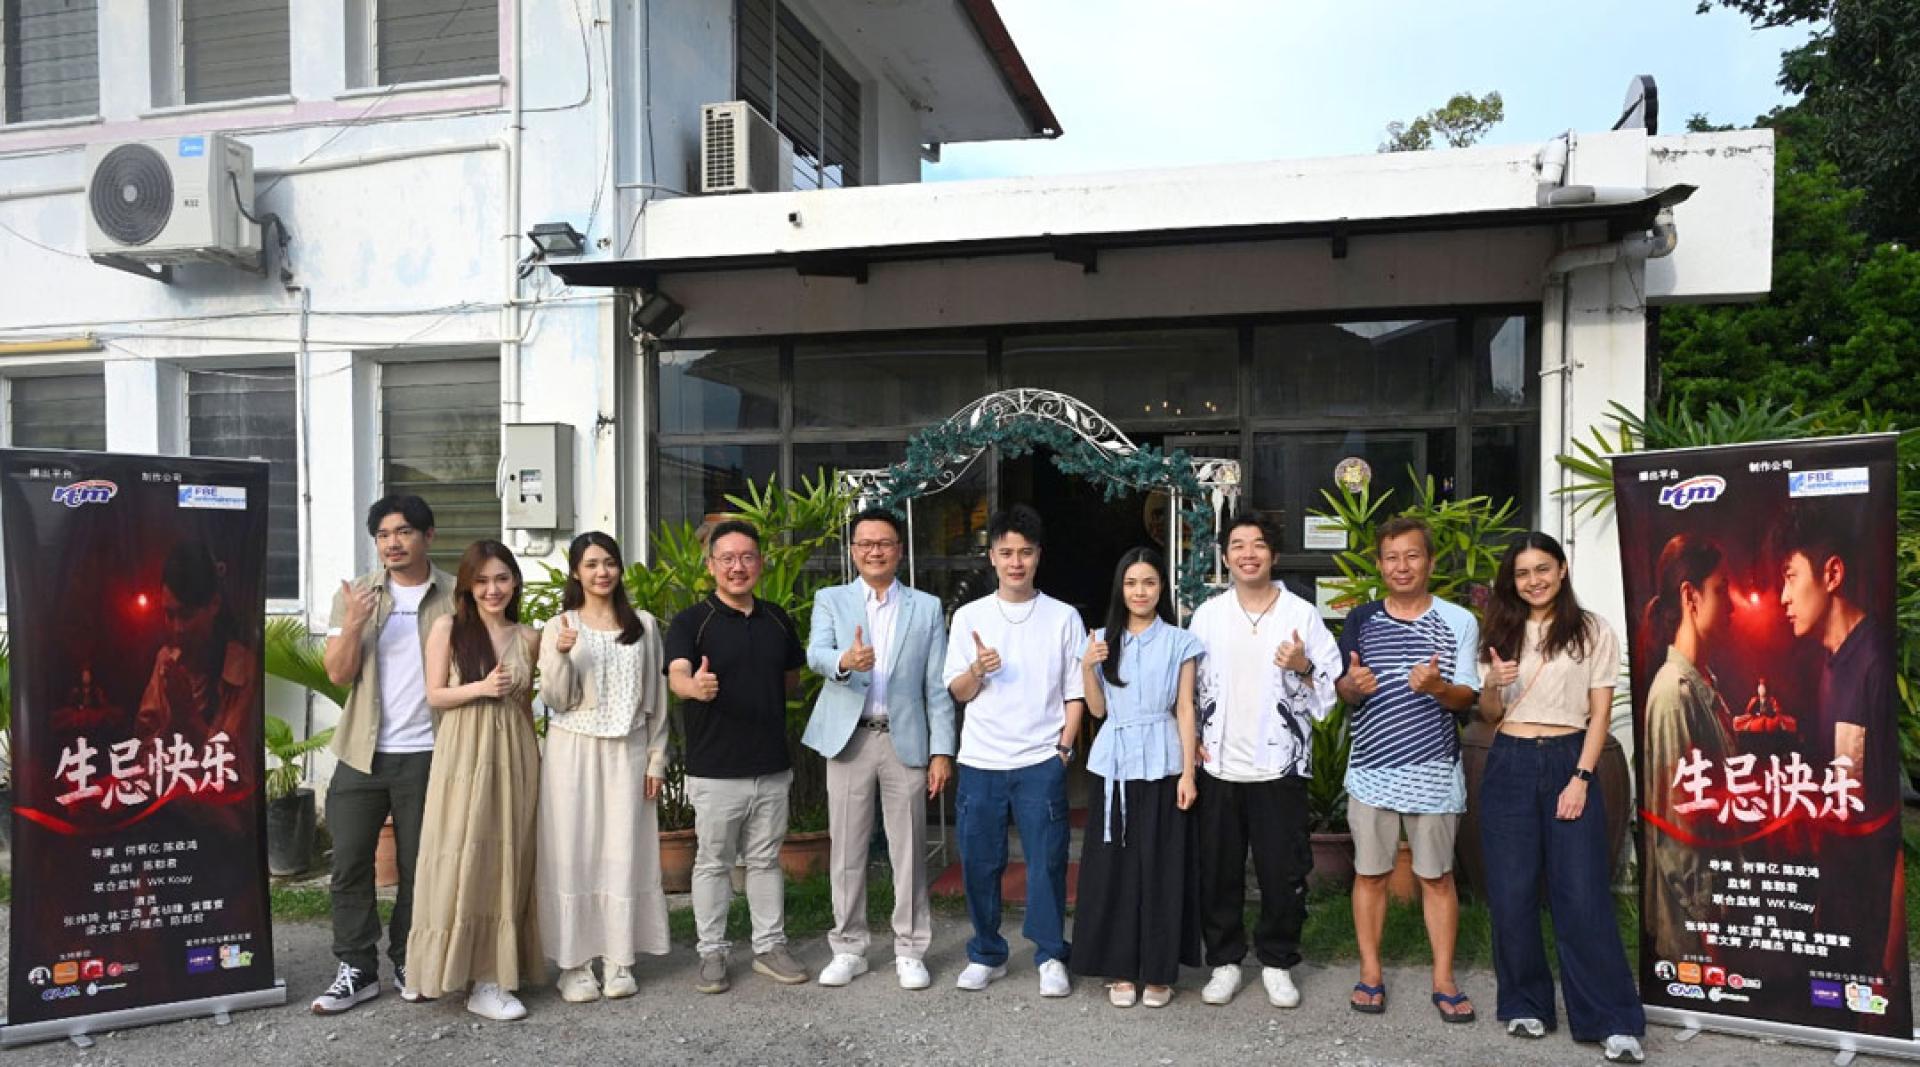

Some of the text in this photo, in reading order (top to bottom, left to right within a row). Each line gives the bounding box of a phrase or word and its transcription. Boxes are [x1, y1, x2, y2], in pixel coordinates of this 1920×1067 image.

[55, 731, 239, 809] 生忌快乐
[1672, 748, 1865, 823] 生忌快乐
[91, 847, 114, 858] 导演
[1709, 859, 1733, 873] 导演
[1767, 898, 1785, 909] WK
[1788, 900, 1815, 914] Koay
